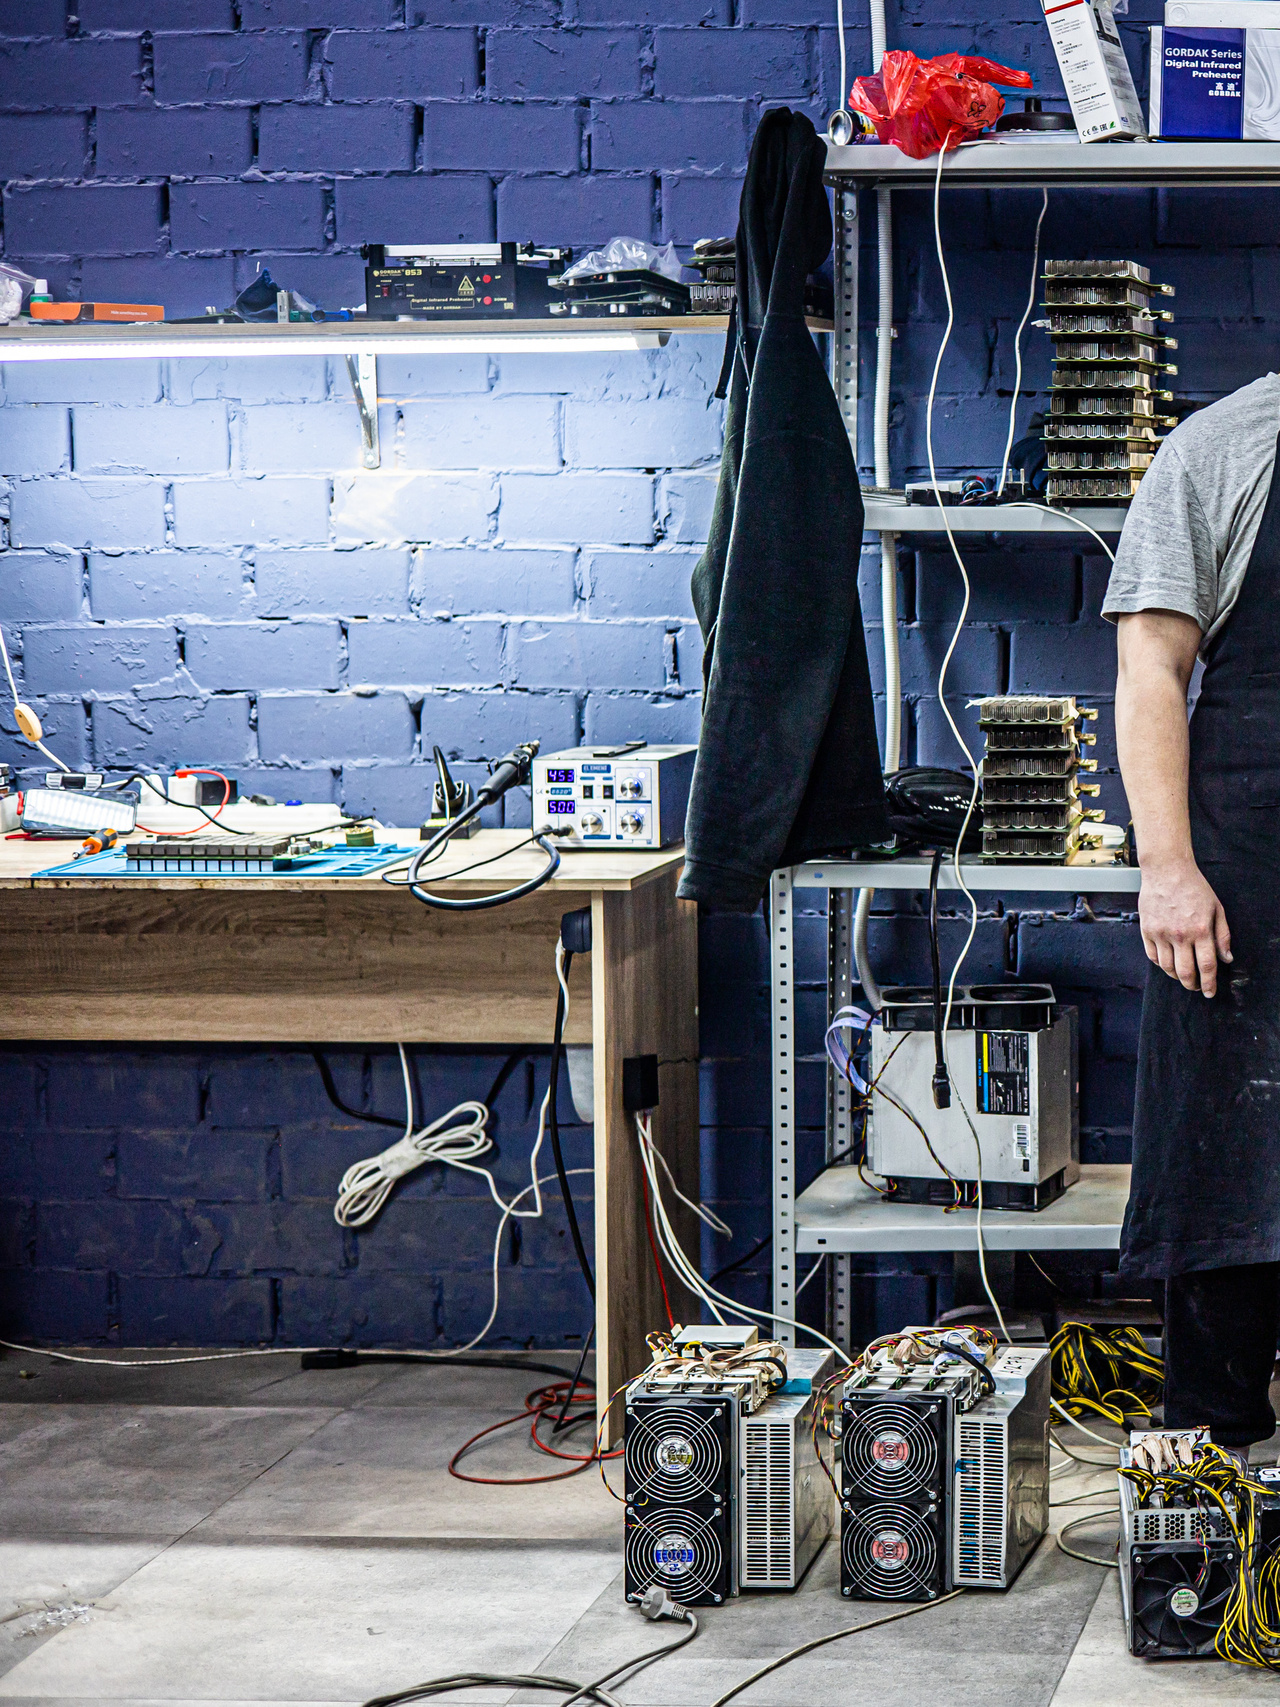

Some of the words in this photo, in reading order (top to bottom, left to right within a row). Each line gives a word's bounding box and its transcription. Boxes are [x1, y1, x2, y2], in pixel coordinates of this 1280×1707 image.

[1165, 48, 1209, 57] GORDAK
[1211, 50, 1242, 58] Series
[1165, 60, 1198, 68] Digital
[1201, 61, 1241, 69] Infrared
[1192, 71, 1241, 79] Preheater
[549, 770, 574, 782] 453
[549, 801, 575, 813] 500
